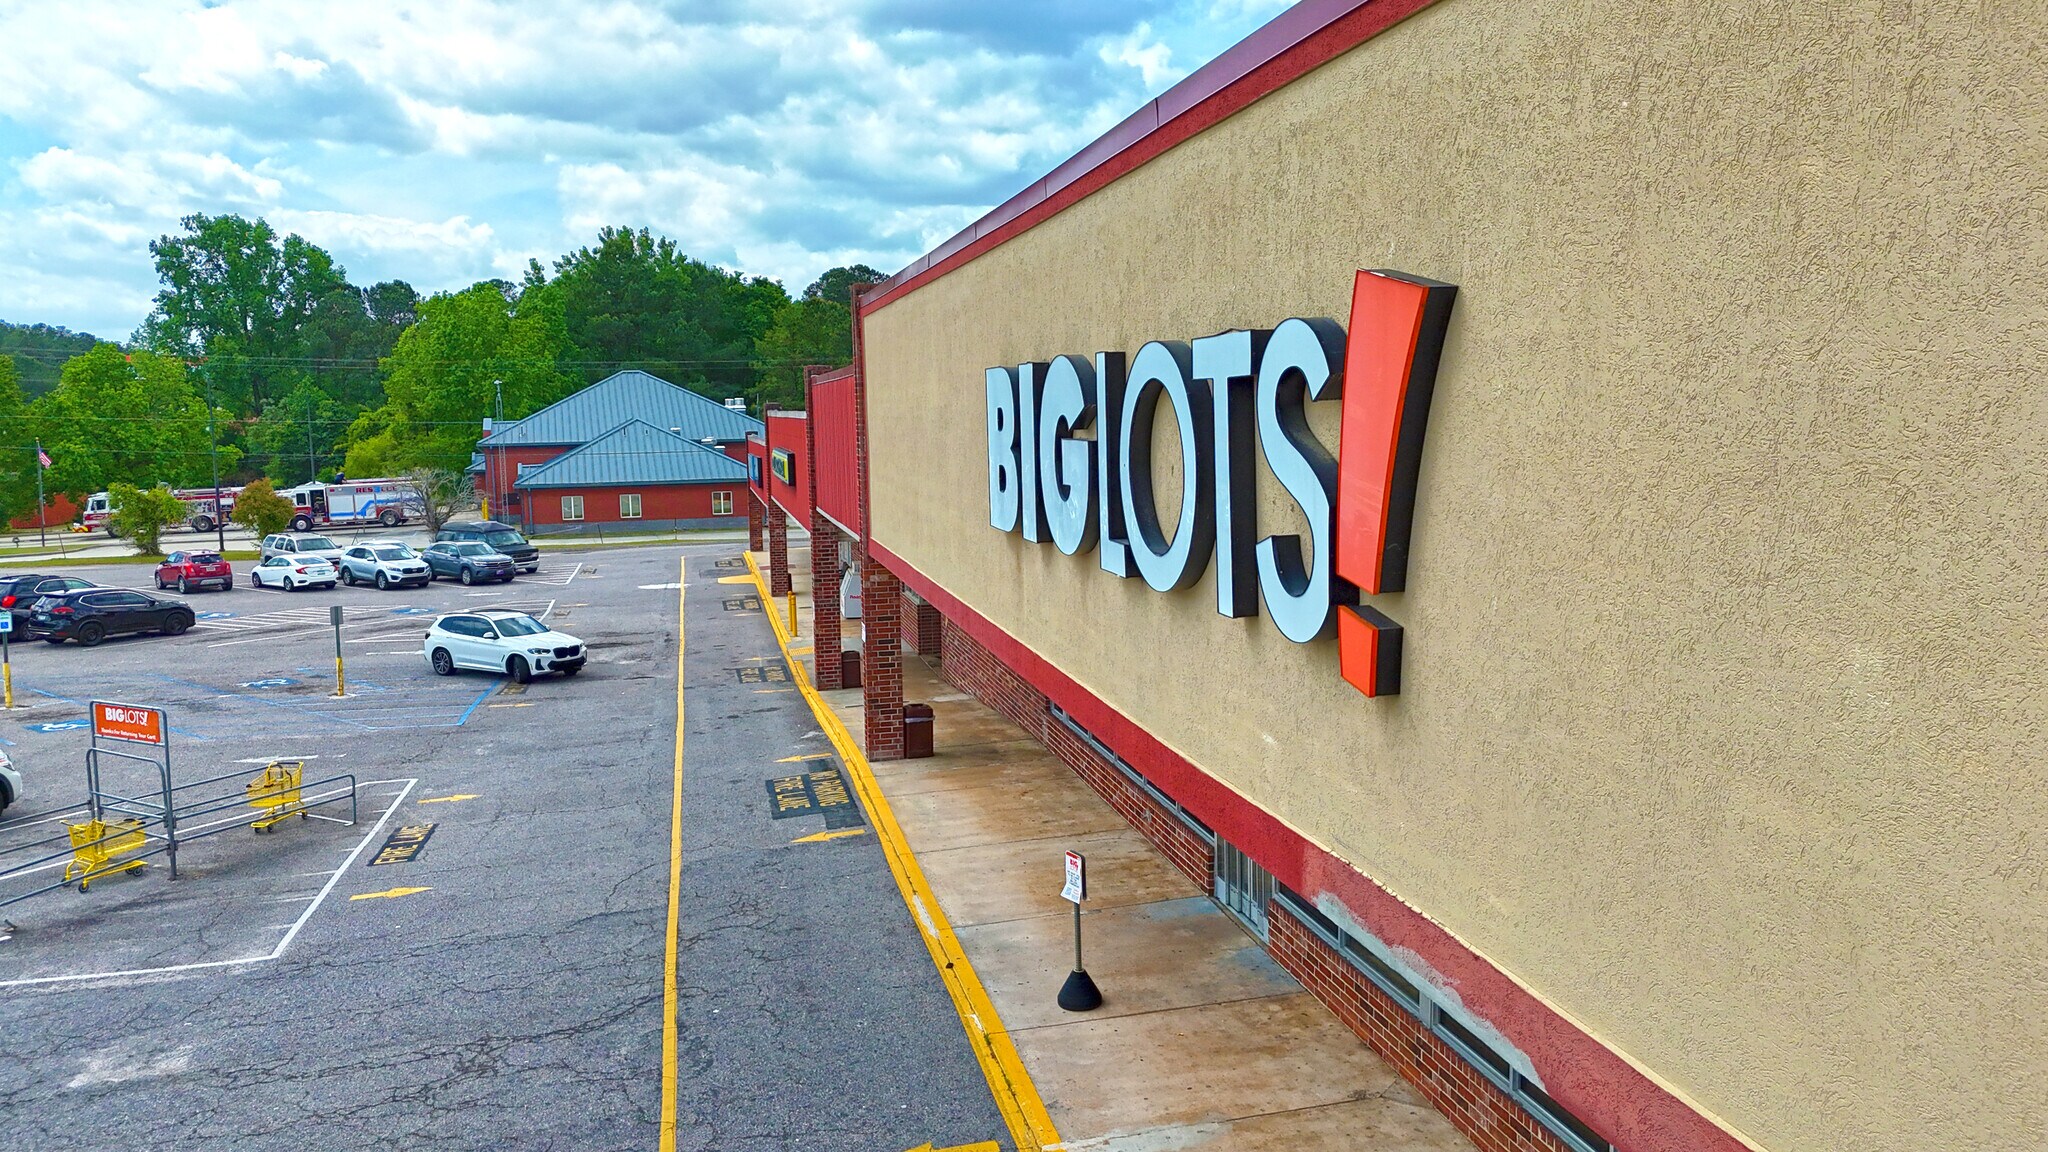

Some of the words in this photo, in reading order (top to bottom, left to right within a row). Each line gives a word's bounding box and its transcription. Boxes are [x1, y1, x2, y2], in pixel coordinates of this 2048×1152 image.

[772, 775, 805, 793] FIRE
[776, 791, 811, 811] LANE
[389, 823, 434, 845] LANE
[373, 844, 419, 865] FIRE
